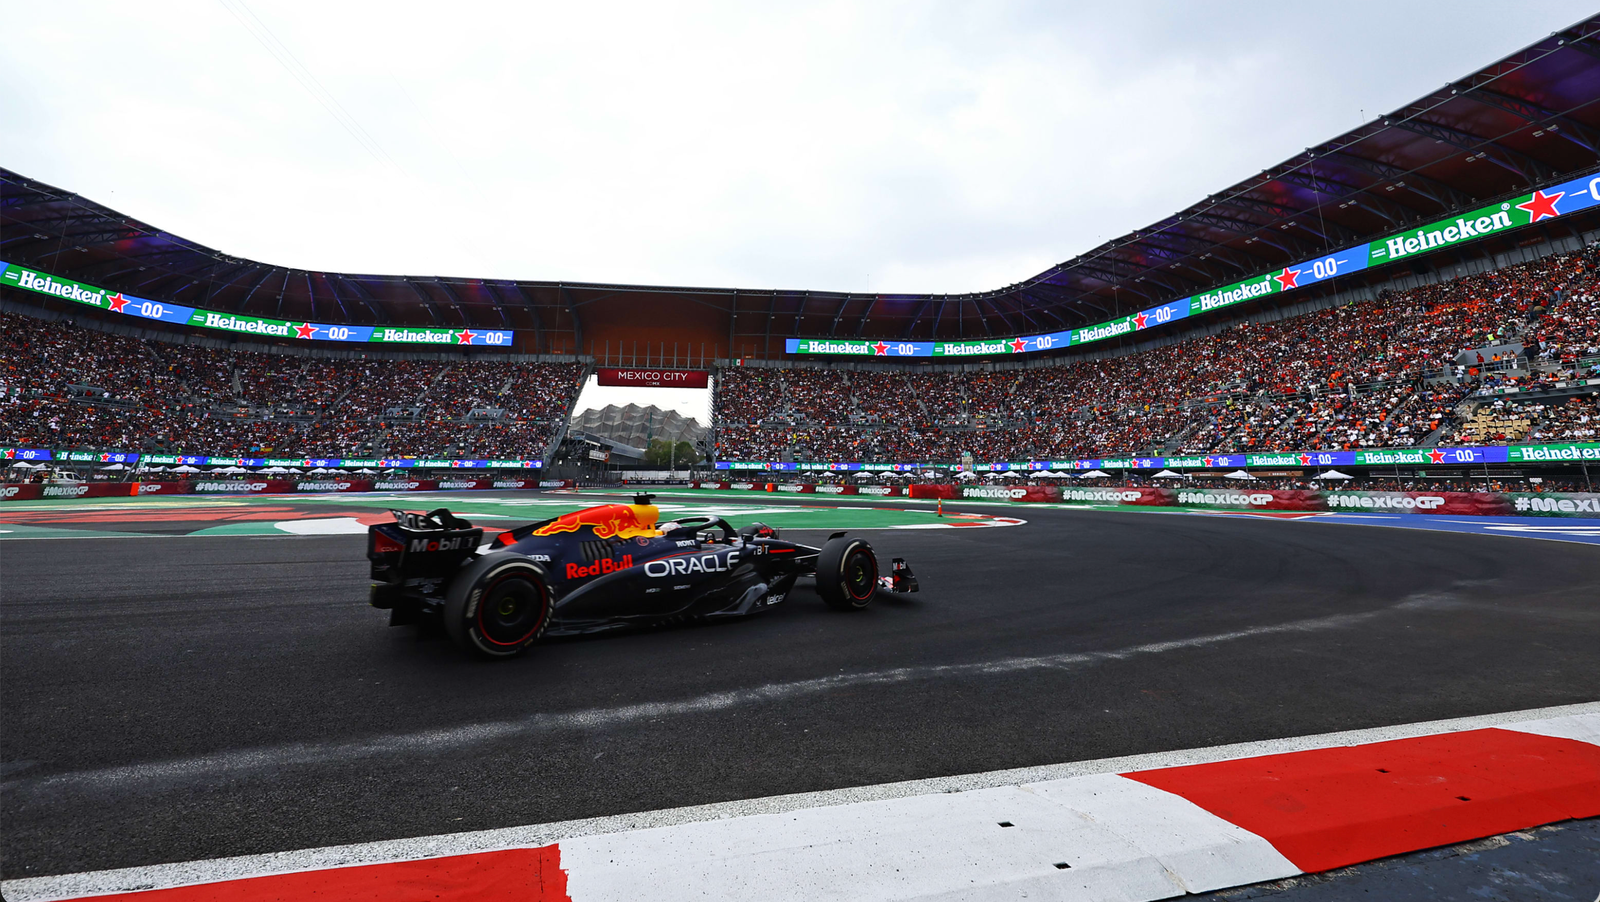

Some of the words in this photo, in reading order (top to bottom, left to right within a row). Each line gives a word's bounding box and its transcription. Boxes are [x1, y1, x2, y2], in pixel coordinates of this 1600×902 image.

[1386, 211, 1513, 259] Heineken
[18, 270, 105, 306] Heineken
[1199, 281, 1272, 311] Heineken
[204, 313, 291, 336] Heineken
[1079, 319, 1131, 342] Heineken
[383, 329, 454, 343] Heineken
[808, 341, 869, 354] Heineken
[944, 341, 1006, 355] Heineken
[618, 372, 660, 380] MEXICO
[664, 372, 688, 380] CITY
[1252, 455, 1296, 466] Heineken
[1364, 451, 1424, 464] Heineken
[196, 482, 268, 492] #MexicoGP
[297, 482, 352, 490] #MexicoGP
[963, 488, 1026, 498] #MexicoGP
[1062, 490, 1142, 502] #MexicoGP
[1178, 492, 1274, 505] #MexicoGP
[1327, 494, 1445, 508] #MexicoGP
[410, 538, 462, 552] Mobil
[566, 560, 601, 580] Red
[602, 554, 634, 574] Bull
[644, 552, 740, 578] ORACLE
